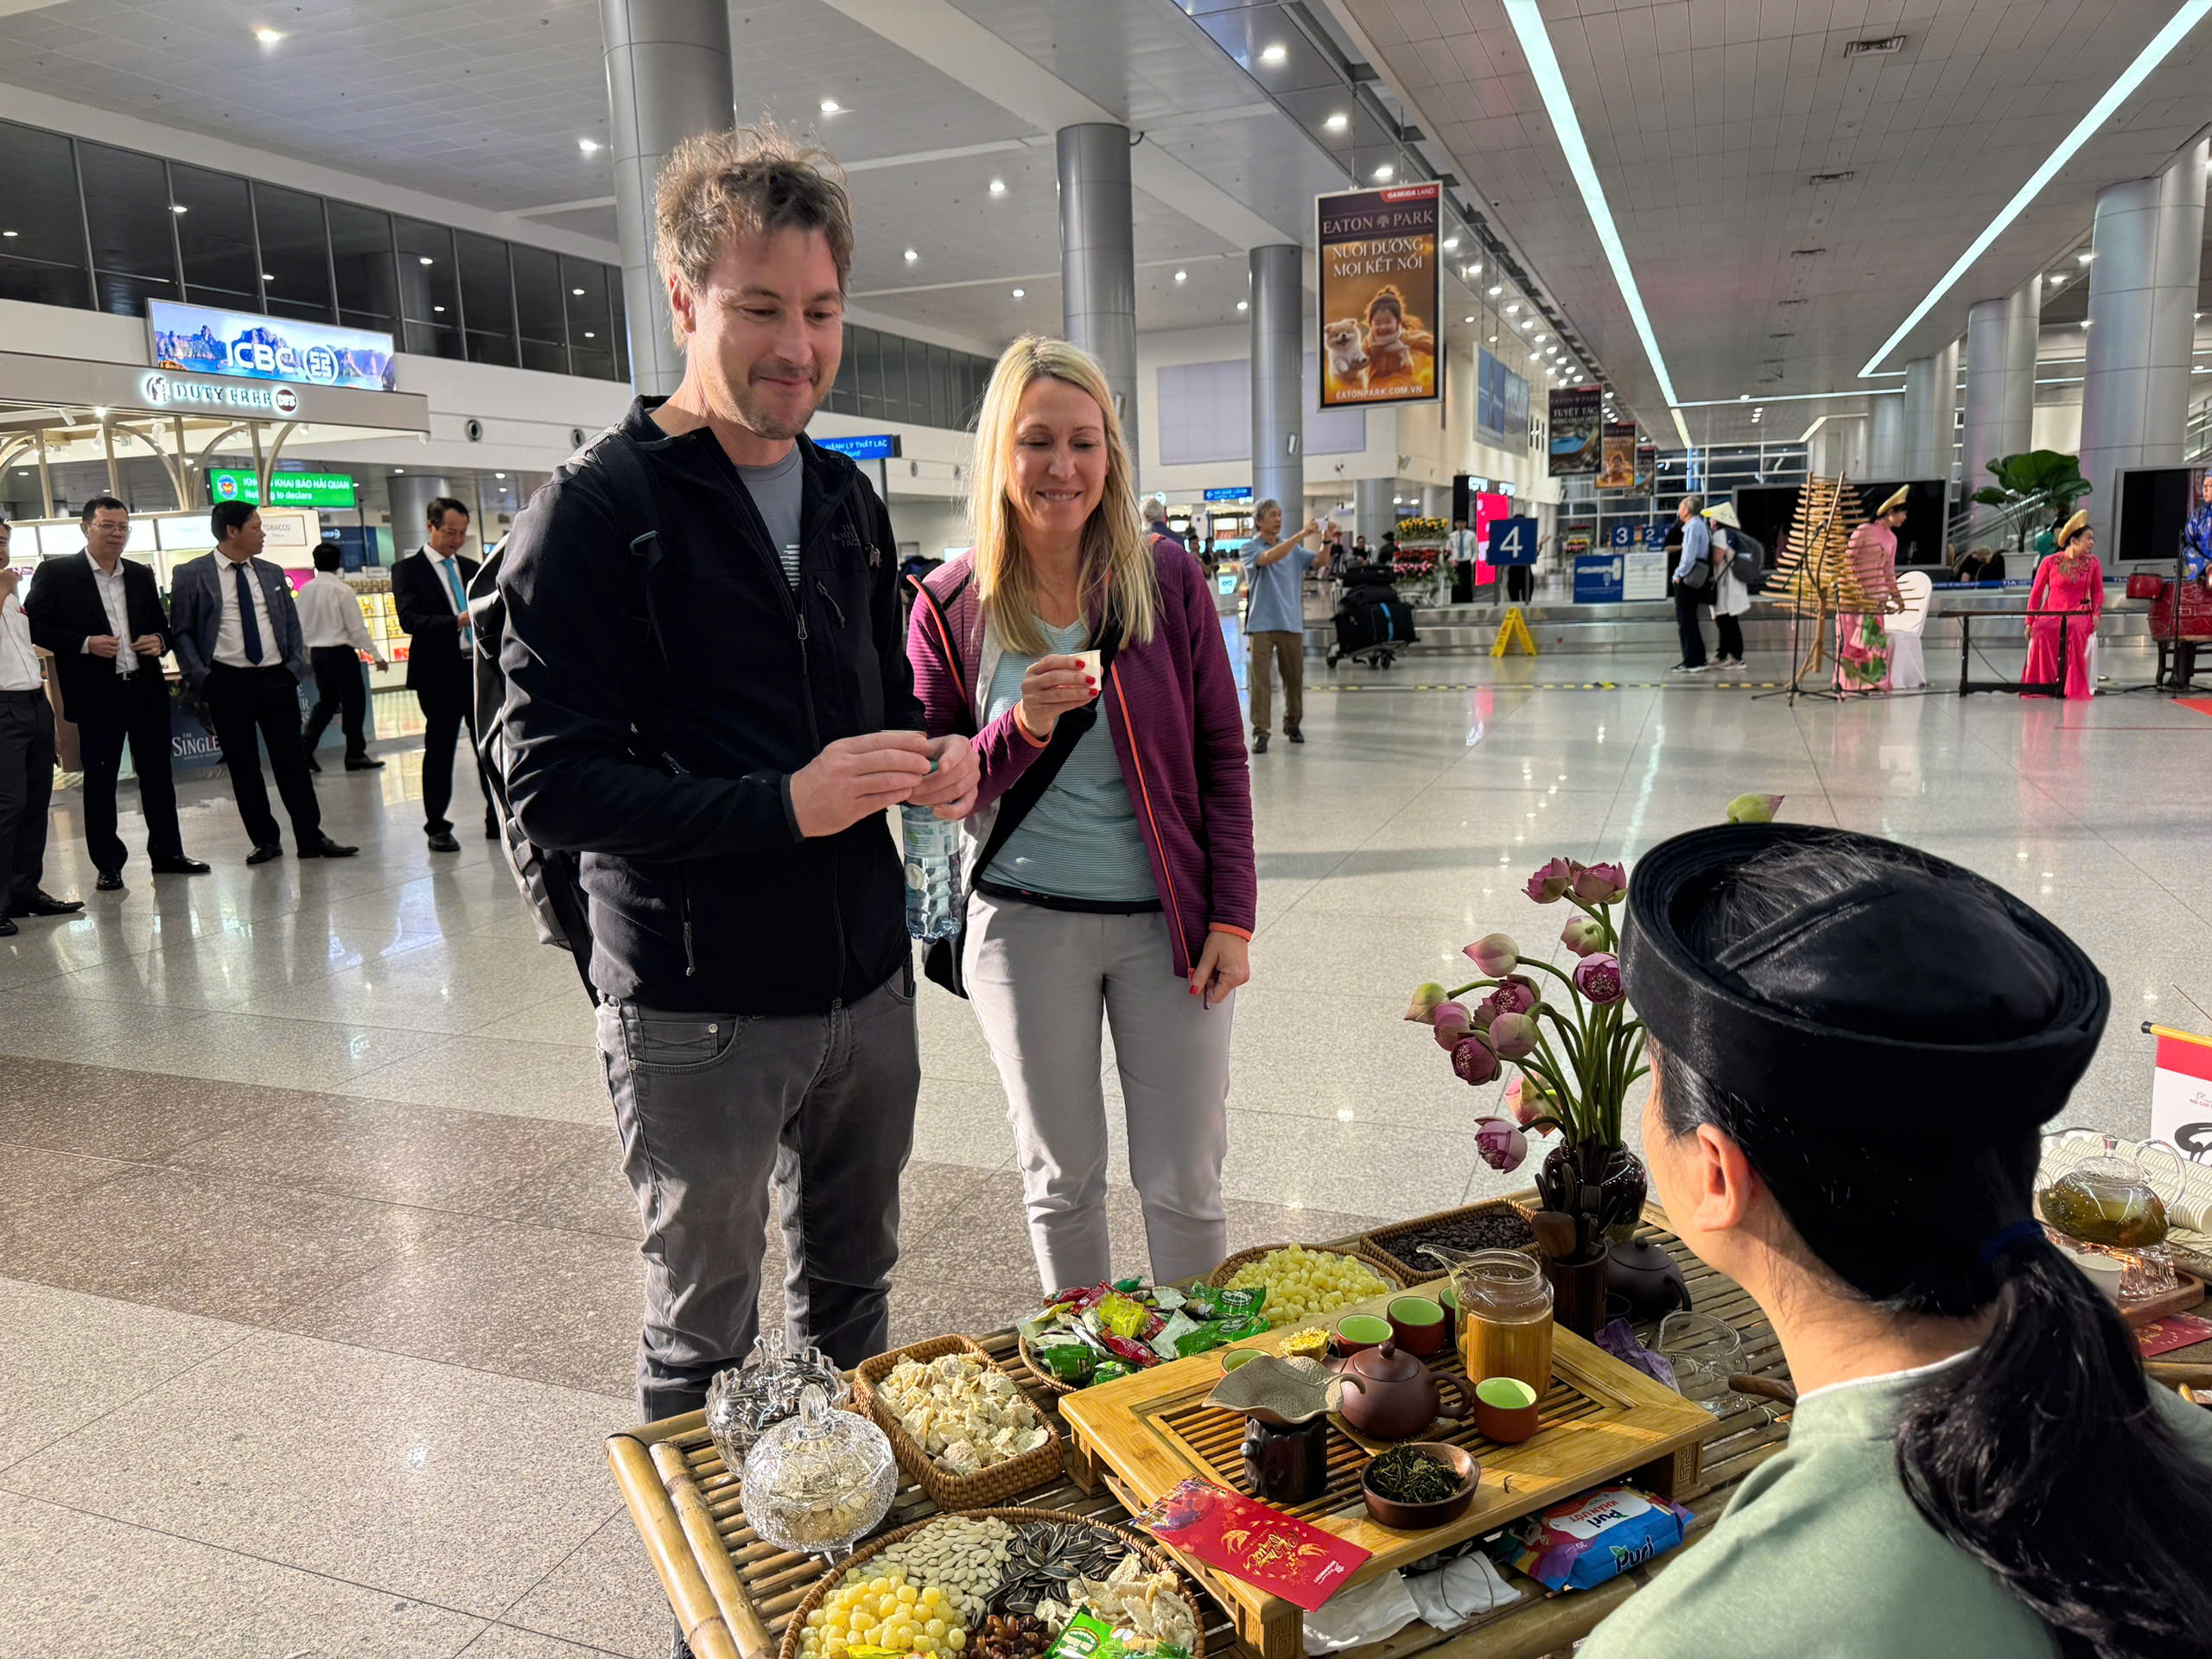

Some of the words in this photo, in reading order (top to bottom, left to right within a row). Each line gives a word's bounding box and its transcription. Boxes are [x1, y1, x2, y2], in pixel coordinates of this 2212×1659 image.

[1417, 188, 1434, 196] LAND
[1323, 216, 1373, 234] EATON
[1393, 210, 1433, 227] PARK
[1333, 242, 1367, 260] NUÔI
[1334, 261, 1361, 277] MỌI
[1365, 255, 1393, 274] KẾT
[1397, 253, 1422, 270] NỐI
[226, 340, 296, 373] ICBC
[175, 384, 223, 402] DUTY
[230, 389, 272, 406] FREE
[1335, 386, 1423, 400] EATONPARK.COM.VN
[274, 478, 294, 488] KHAI
[296, 477, 312, 488] BÁO
[327, 480, 349, 489] QUAN
[285, 491, 312, 499] declare
[831, 531, 857, 542] NORT
[1499, 525, 1523, 558] 4
[1616, 527, 1628, 543] 3
[1645, 528, 1654, 540] 2
[841, 538, 858, 548] FAC
[1611, 1535, 1654, 1573] Puri
